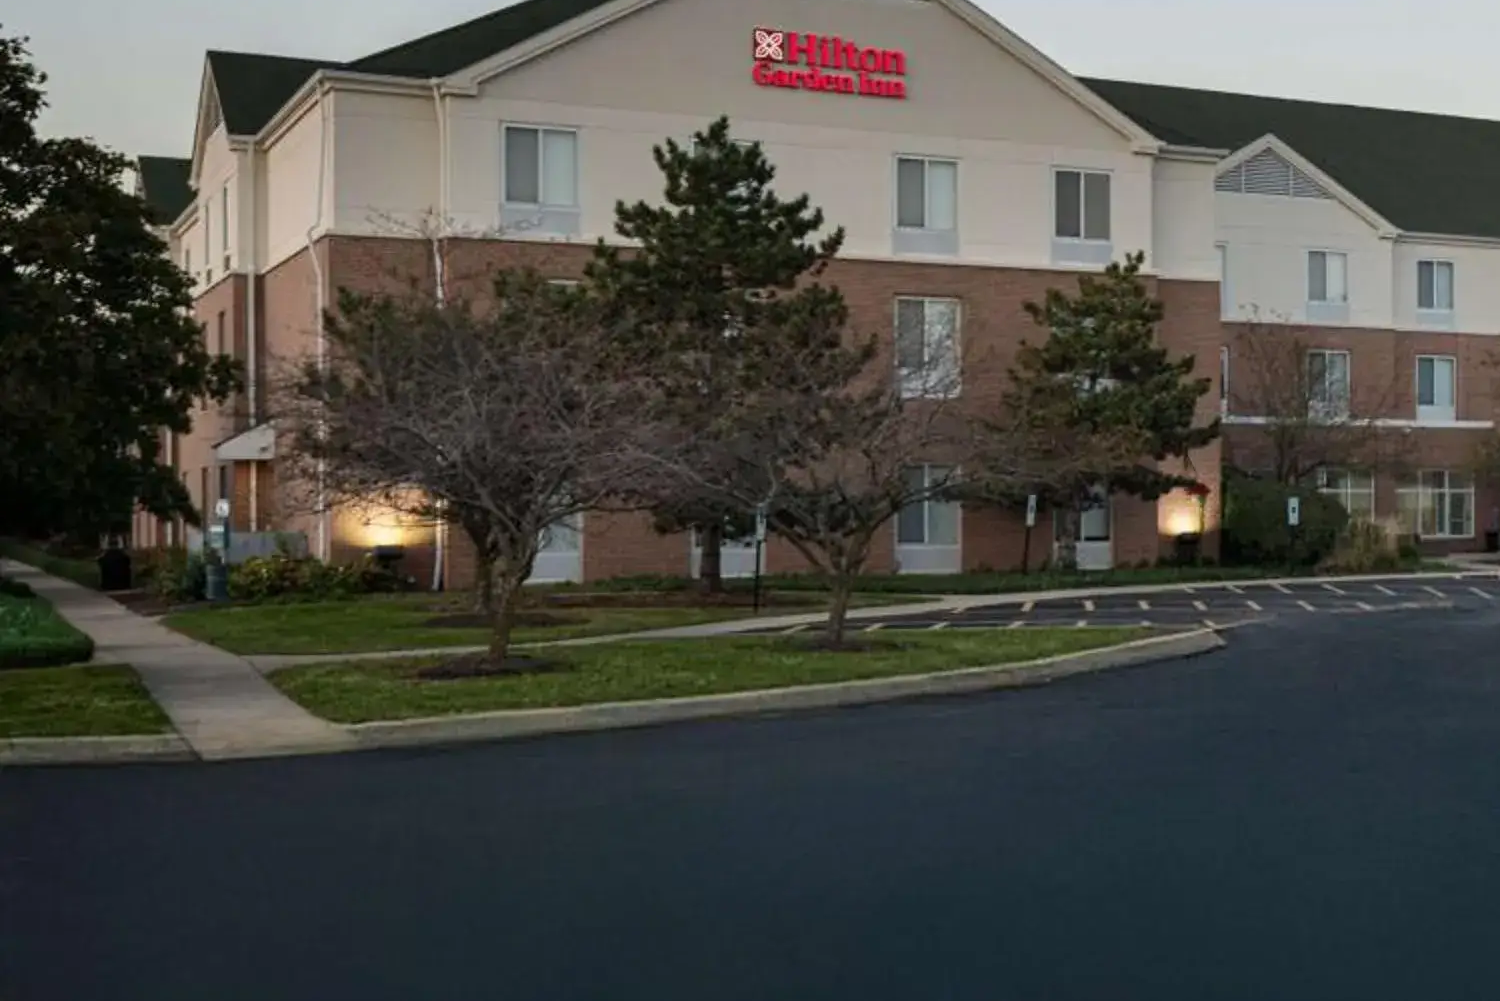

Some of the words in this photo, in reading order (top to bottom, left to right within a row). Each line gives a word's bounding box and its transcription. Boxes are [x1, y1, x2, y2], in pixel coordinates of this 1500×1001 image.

[786, 31, 906, 76] Hilton
[752, 60, 854, 94] Garden
[858, 70, 906, 99] Inn
